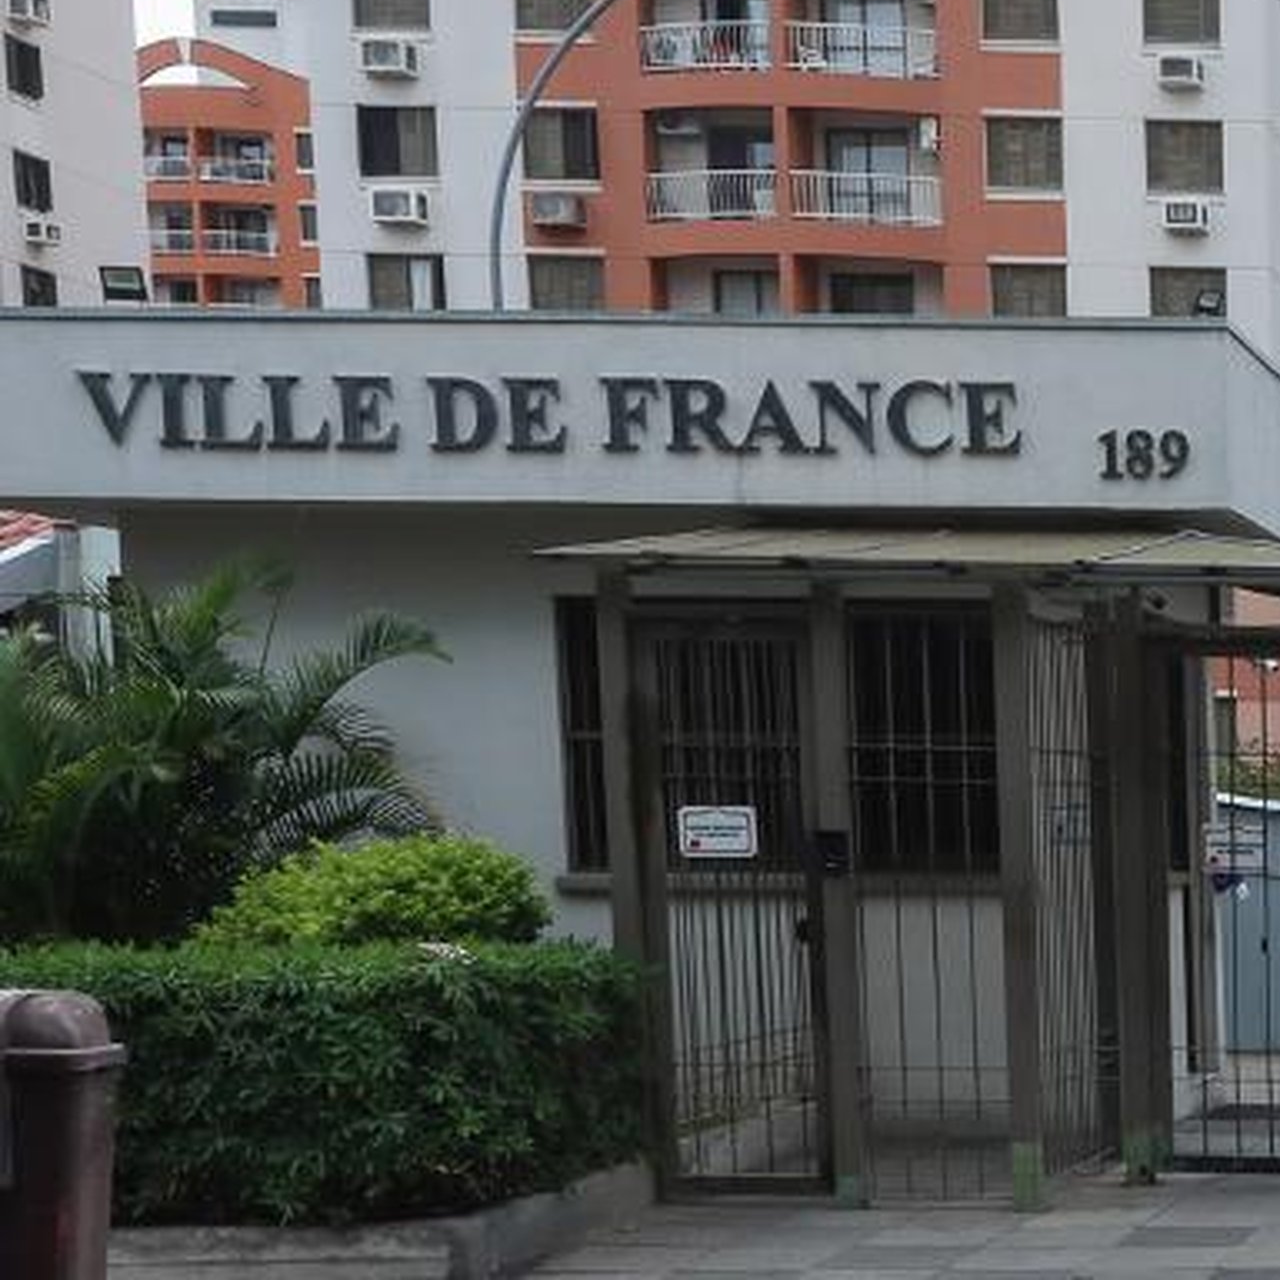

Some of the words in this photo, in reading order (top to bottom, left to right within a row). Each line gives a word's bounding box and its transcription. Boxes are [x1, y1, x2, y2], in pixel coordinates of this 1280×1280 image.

[76, 369, 401, 452] VILLE
[426, 376, 568, 454] DE
[600, 377, 1022, 458] FRANCE
[1097, 429, 1191, 480] 189
